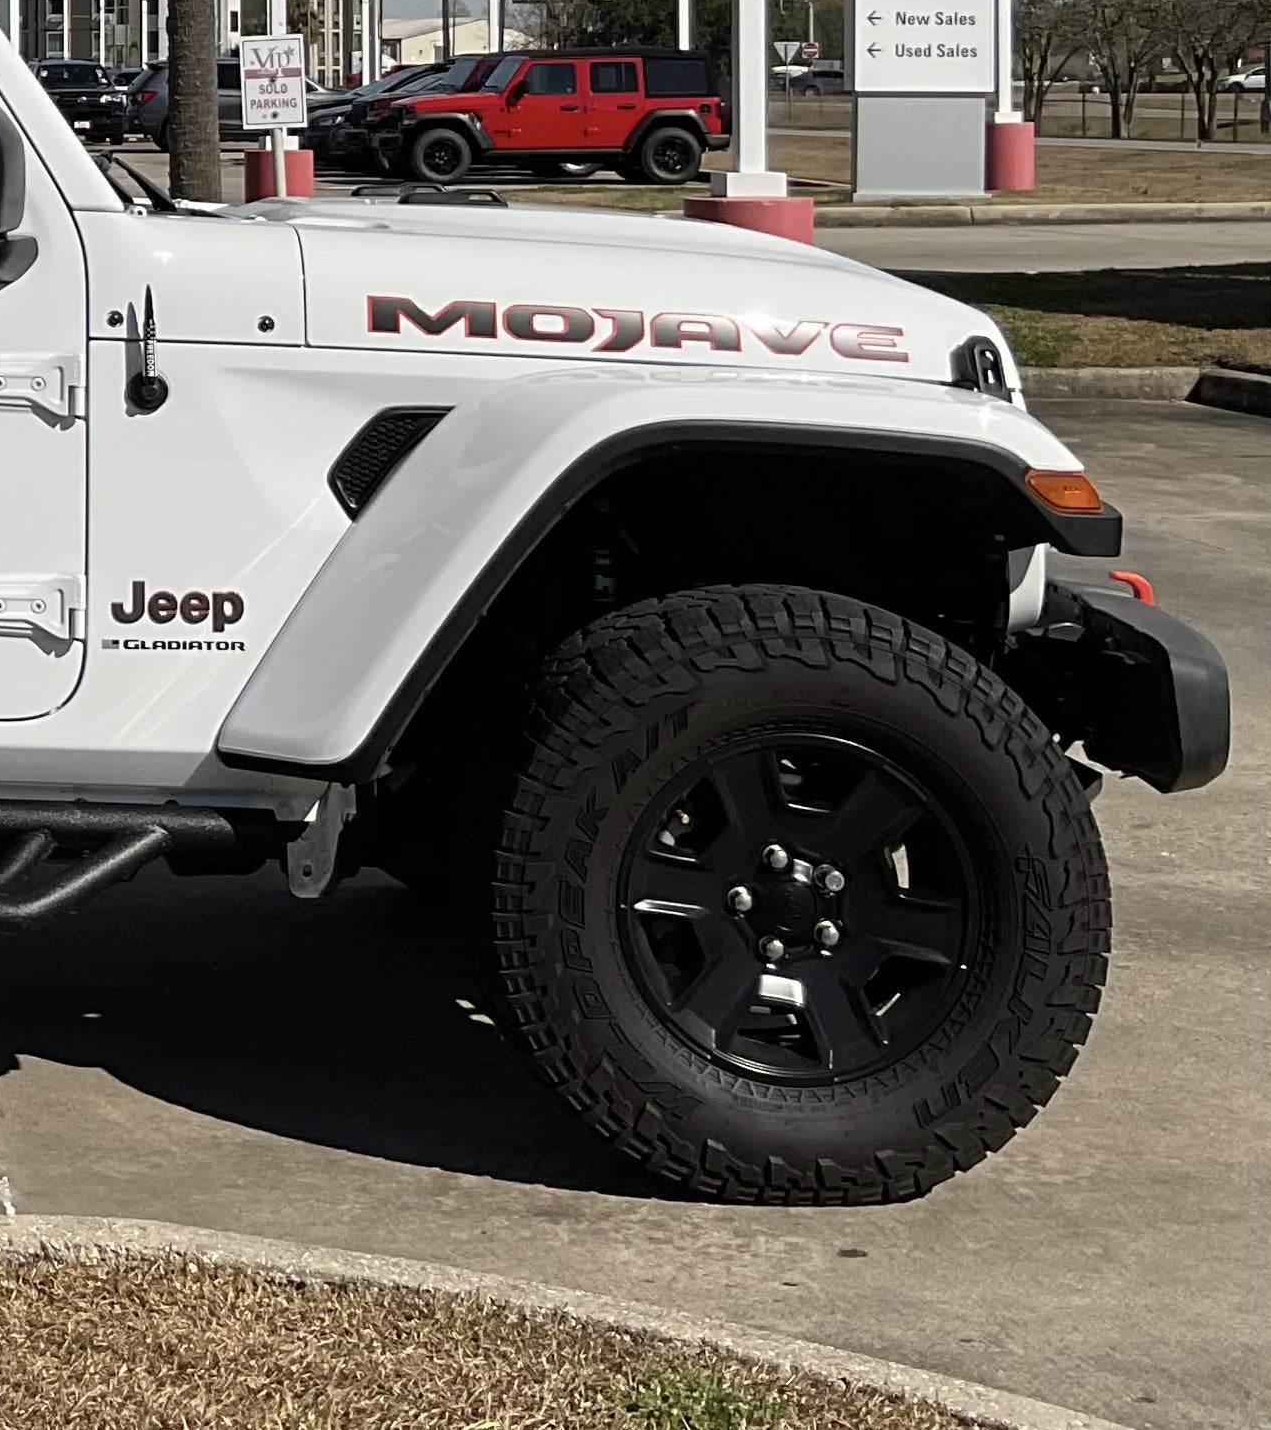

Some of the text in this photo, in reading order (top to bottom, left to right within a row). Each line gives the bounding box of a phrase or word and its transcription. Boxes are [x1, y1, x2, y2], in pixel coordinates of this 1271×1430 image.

[895, 11, 976, 26] New Sales
[894, 43, 978, 58] Used Sales
[258, 83, 288, 94] SOLD
[250, 97, 298, 110] PARKING
[366, 294, 910, 364] MOJAVE
[110, 580, 245, 634] Jeep
[122, 639, 246, 652] GLADIATOR
